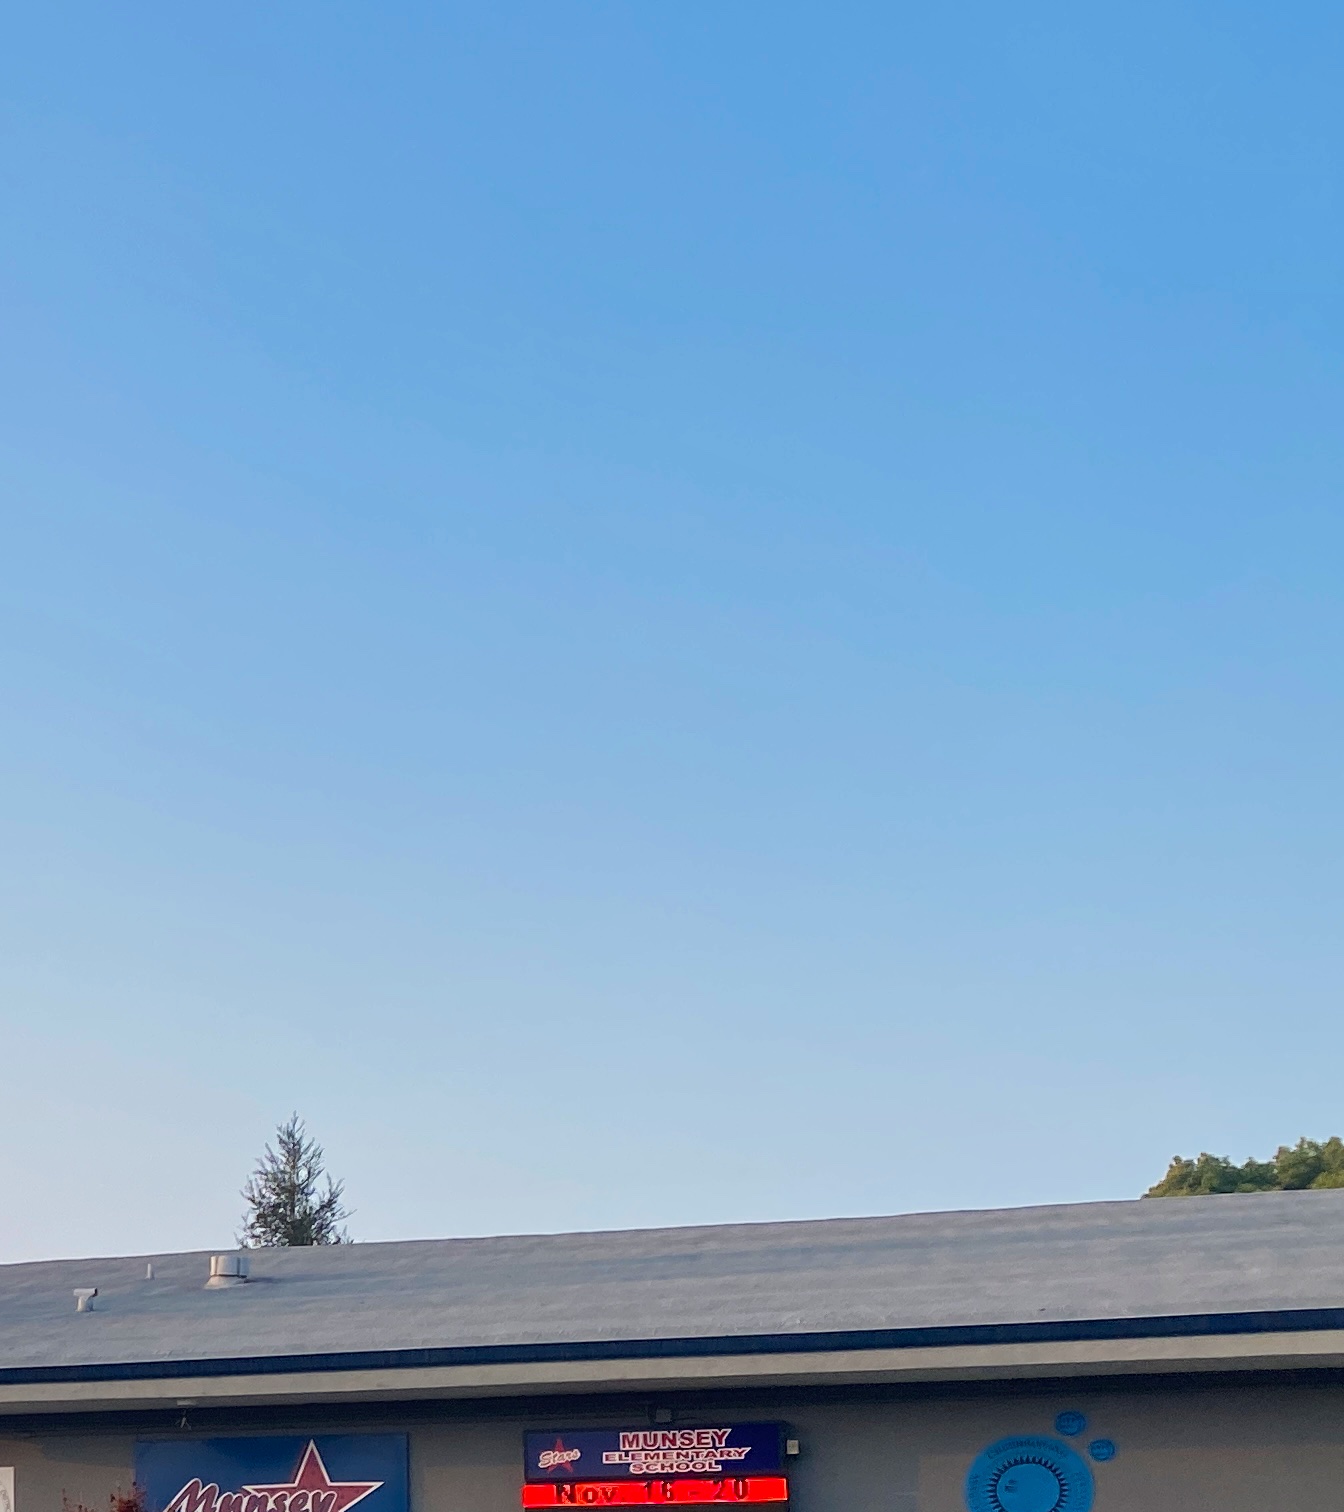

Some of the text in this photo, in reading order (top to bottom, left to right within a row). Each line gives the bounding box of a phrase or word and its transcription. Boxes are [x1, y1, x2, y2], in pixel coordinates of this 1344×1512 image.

[620, 1429, 732, 1450] MUNSEY
[537, 1449, 581, 1468] Stars
[603, 1447, 751, 1464] ELEMENTARY
[630, 1461, 722, 1475] SCHOOL
